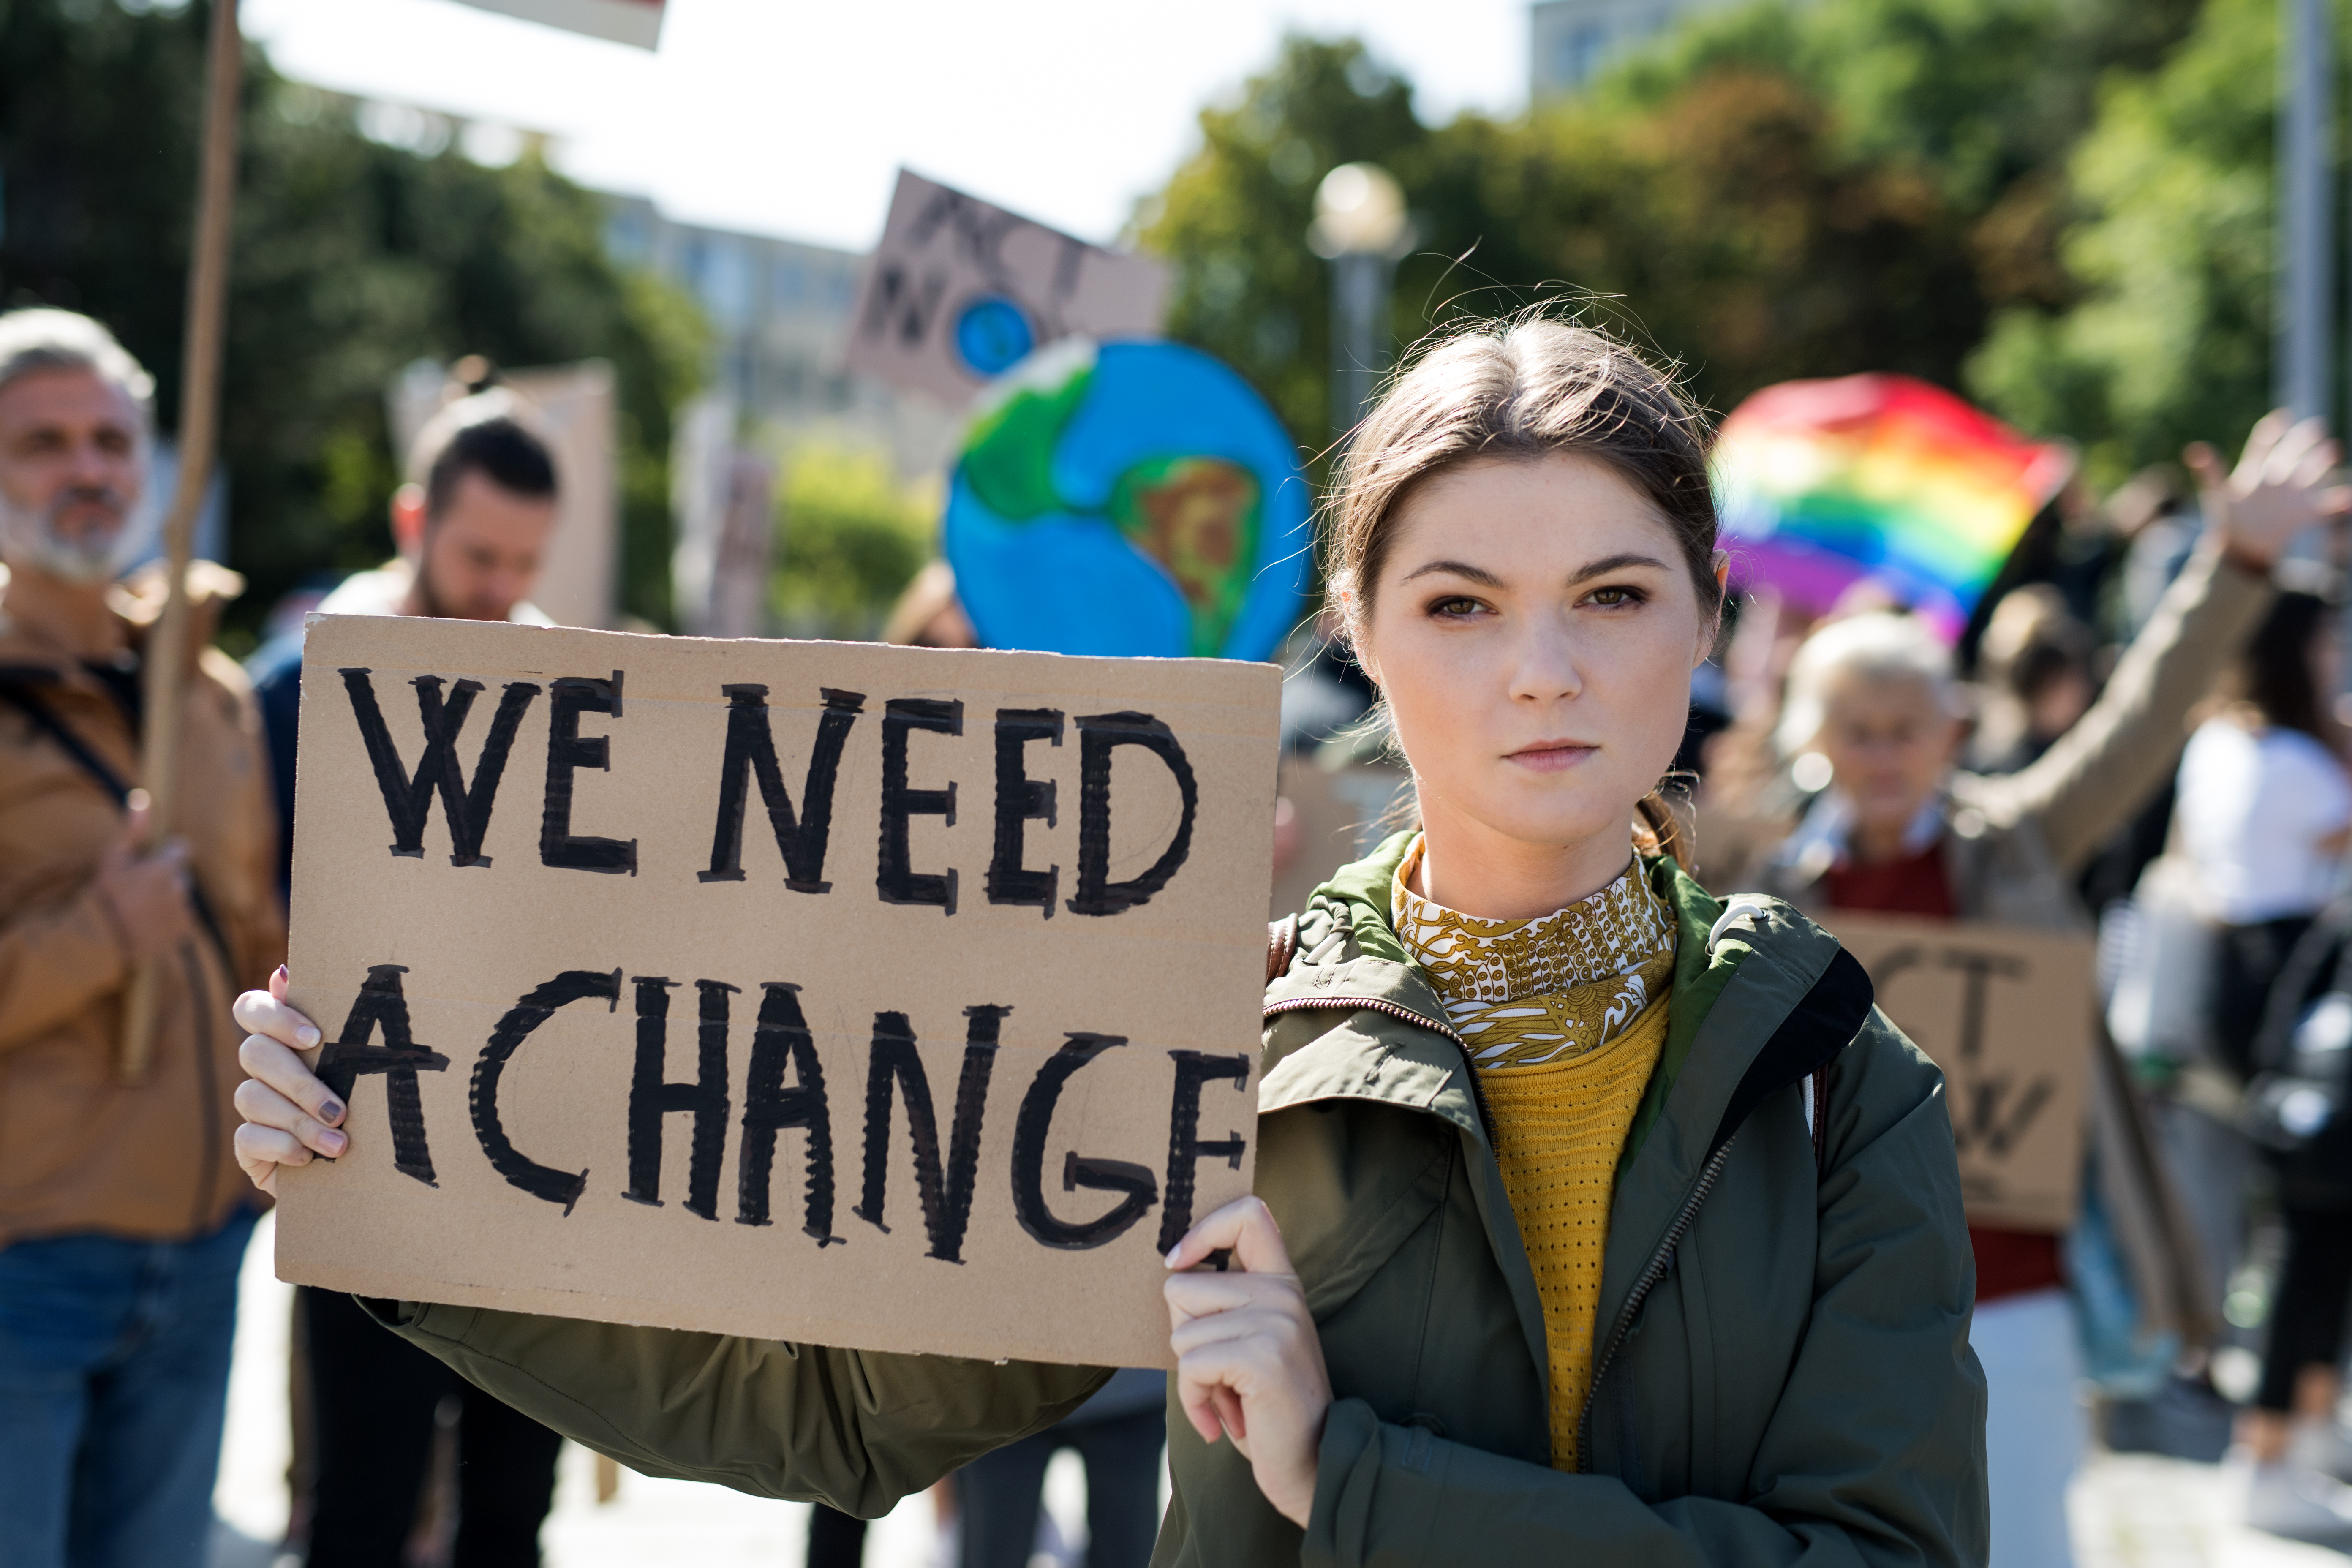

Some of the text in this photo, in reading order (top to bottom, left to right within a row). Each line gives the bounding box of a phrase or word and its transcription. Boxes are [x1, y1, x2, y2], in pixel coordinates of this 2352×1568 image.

[338, 668, 1198, 917] WE NEED
[313, 964, 1250, 1273] A CHANGE
